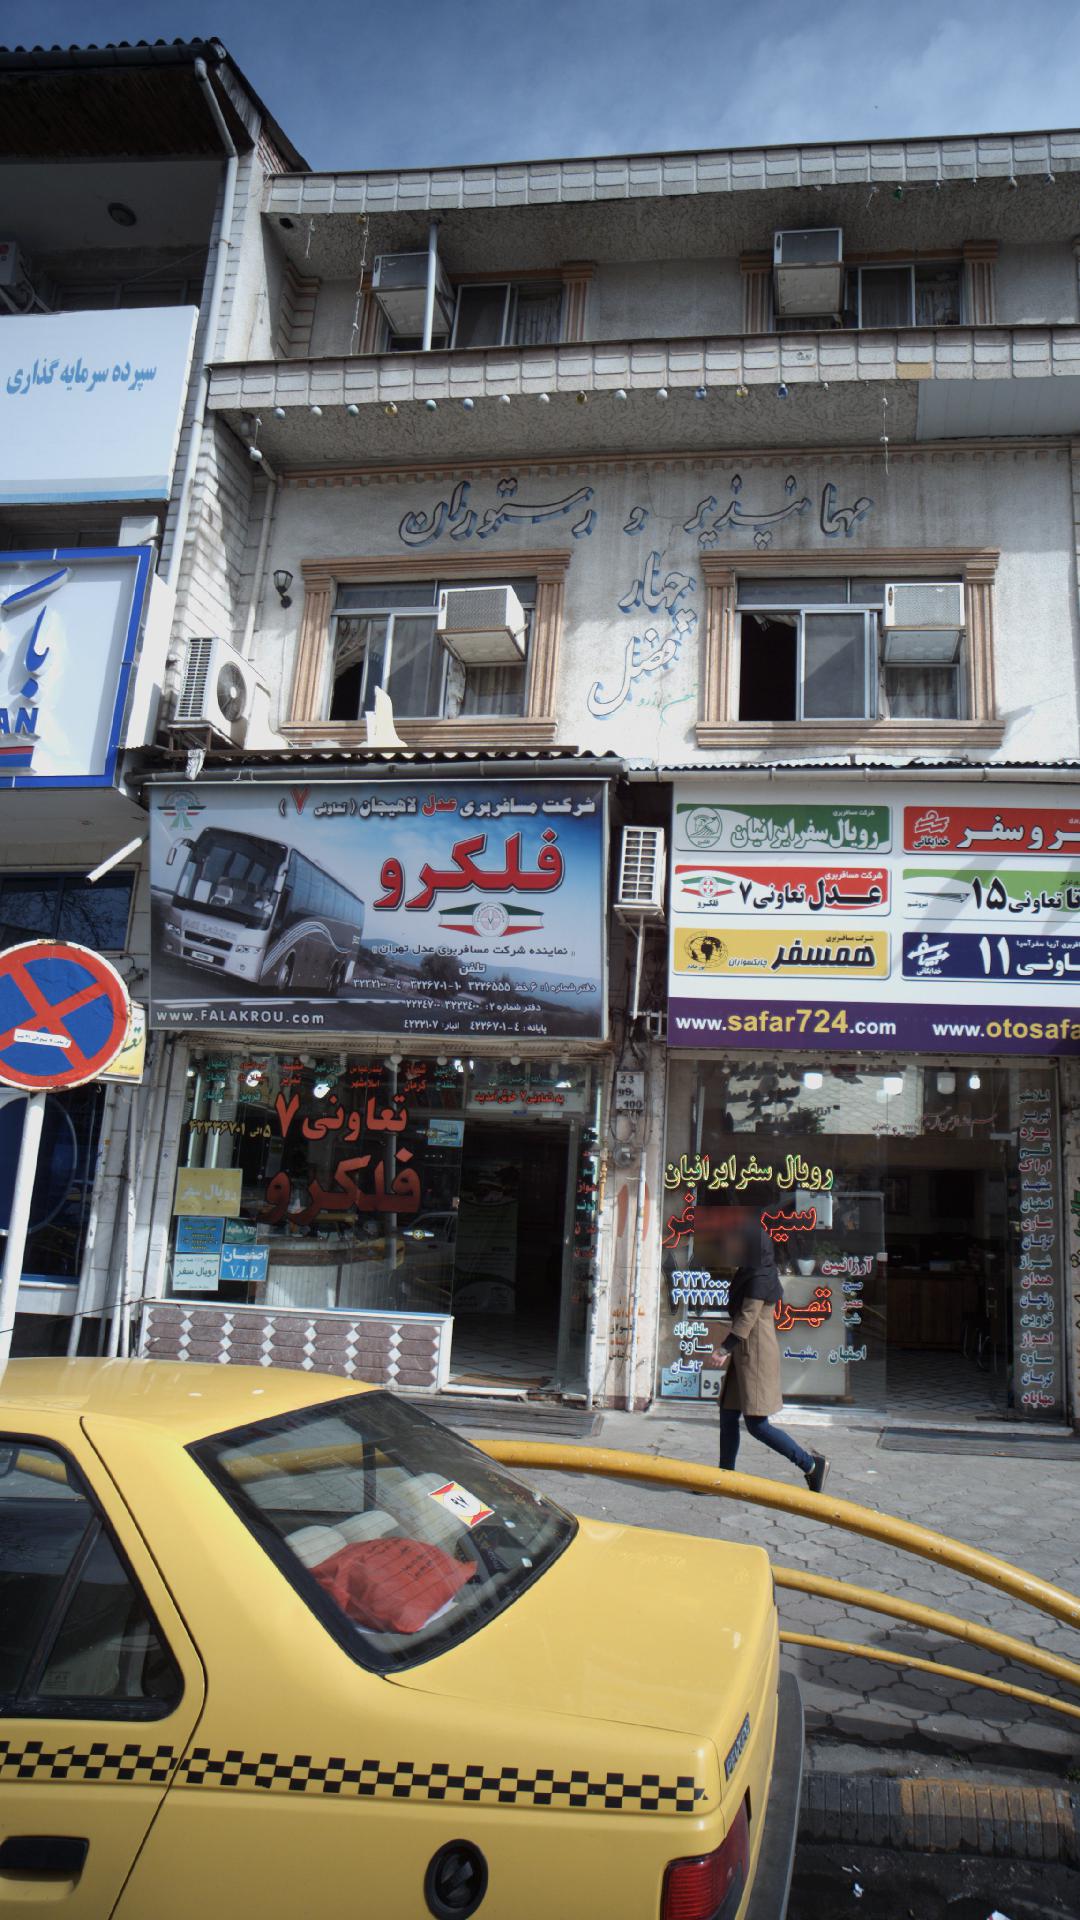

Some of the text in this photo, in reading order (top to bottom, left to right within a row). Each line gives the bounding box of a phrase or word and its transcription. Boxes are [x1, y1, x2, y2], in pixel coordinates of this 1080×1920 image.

[6, 357, 157, 394] سپرده سرمایه گذاری
[399, 477, 595, 547] رستوران
[624, 506, 653, 535] و
[618, 551, 697, 633] چهار
[587, 628, 678, 719] فصل
[359, 796, 417, 817] لاهیجان
[422, 793, 458, 816] عدل
[459, 798, 538, 817] مسافربری
[542, 797, 596, 817] شرکت
[730, 816, 795, 849] ایرانیان
[795, 819, 830, 848] سفر
[830, 817, 880, 849] رویال
[956, 815, 1025, 848] سفر
[373, 827, 565, 911] فلکرو
[860, 872, 884, 880] شرکت
[739, 879, 882, 911] عدل تعاونی ۷
[972, 877, 1008, 911] ۱۵
[1008, 891, 1063, 914] تعاونی
[379, 943, 409, 954] تهران
[412, 944, 435, 954] عدل
[492, 945, 526, 957] شرکت
[770, 938, 876, 971] همسفر
[459, 961, 486, 976] تلفن
[156, 1009, 325, 1025] www.FALAKROU.com
[675, 1008, 897, 1035] www.safar724.com
[275, 1092, 408, 1141] تعاونی ۷
[257, 1147, 421, 1225] فلکرو
[664, 1153, 834, 1190] رویال سفر ایرانیان
[223, 1247, 268, 1262] اصفهان
[229, 1265, 259, 1279] V.I.P
[773, 1287, 833, 1331] تهرا
[680, 1337, 714, 1355] ساوه
[1020, 1350, 1055, 1367] ساوه
